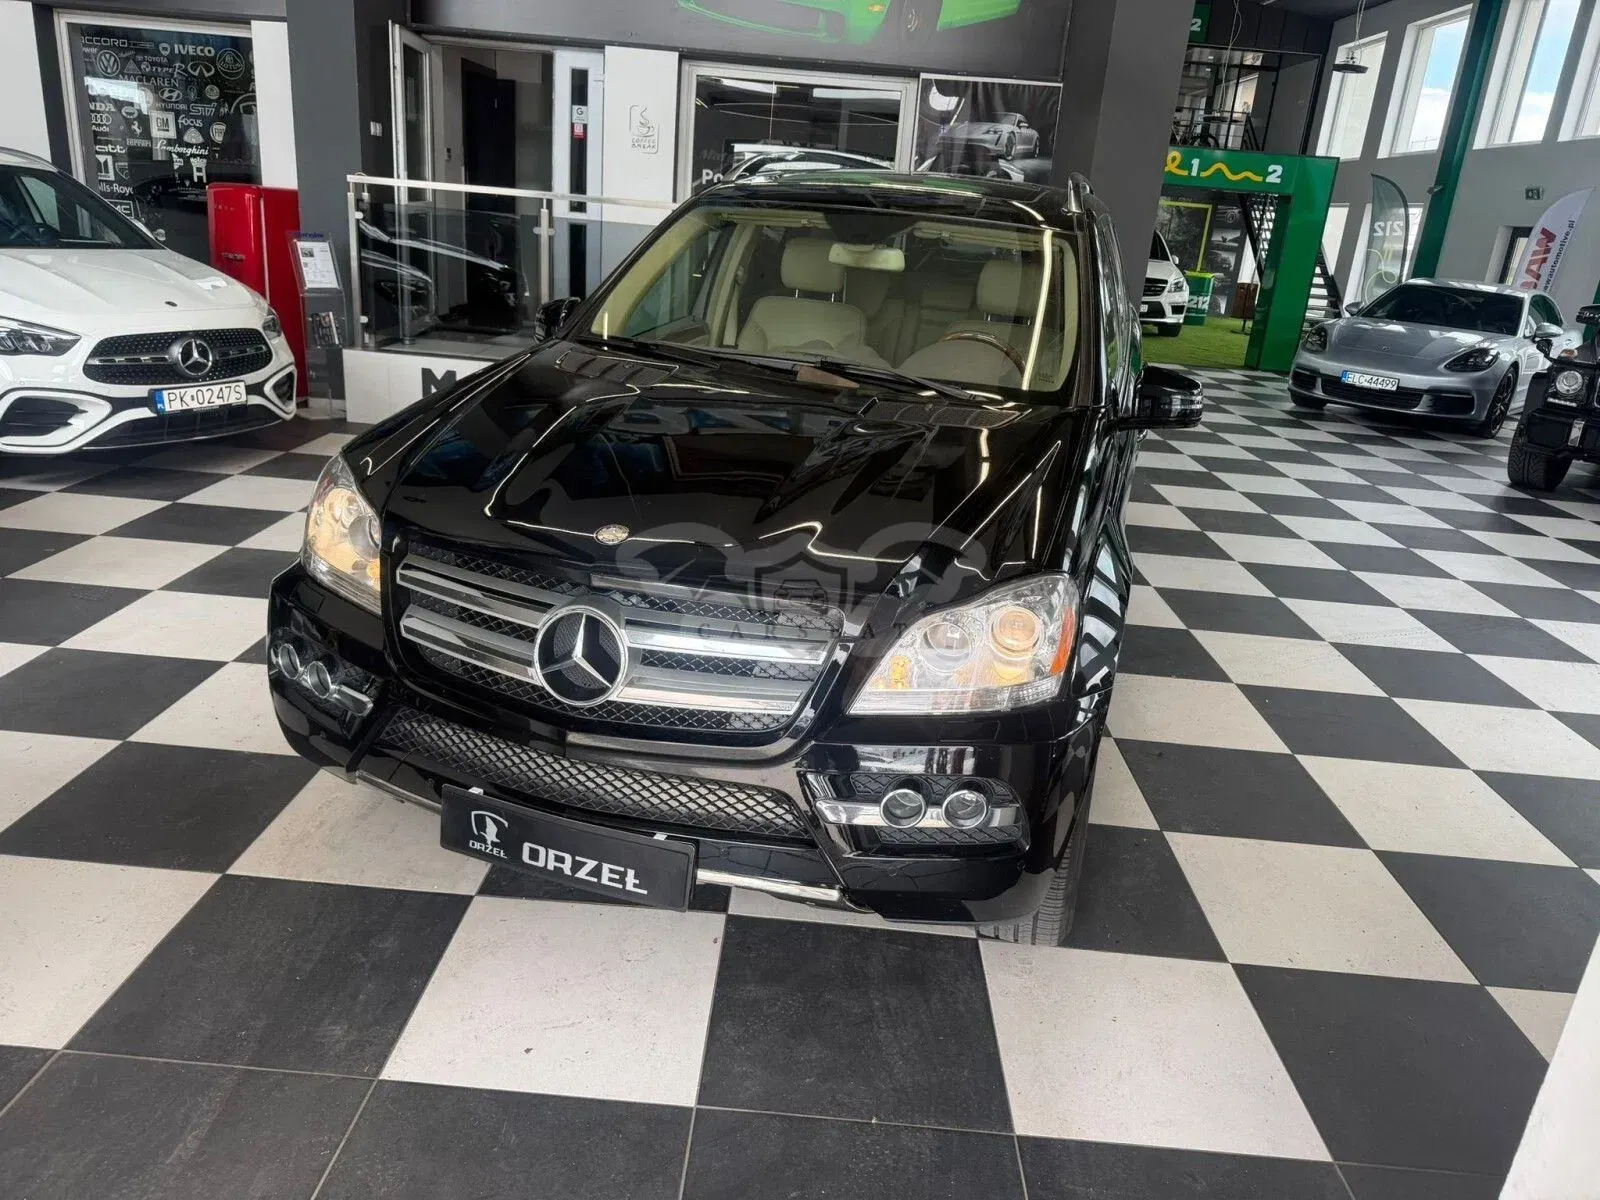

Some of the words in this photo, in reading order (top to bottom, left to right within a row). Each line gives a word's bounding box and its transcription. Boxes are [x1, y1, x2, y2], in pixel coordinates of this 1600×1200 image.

[174, 44, 215, 57] IVECO
[155, 139, 210, 157] Lamborghini
[167, 390, 189, 409] PK
[195, 384, 243, 405] 0247S
[522, 841, 648, 895] ORZEŁ
